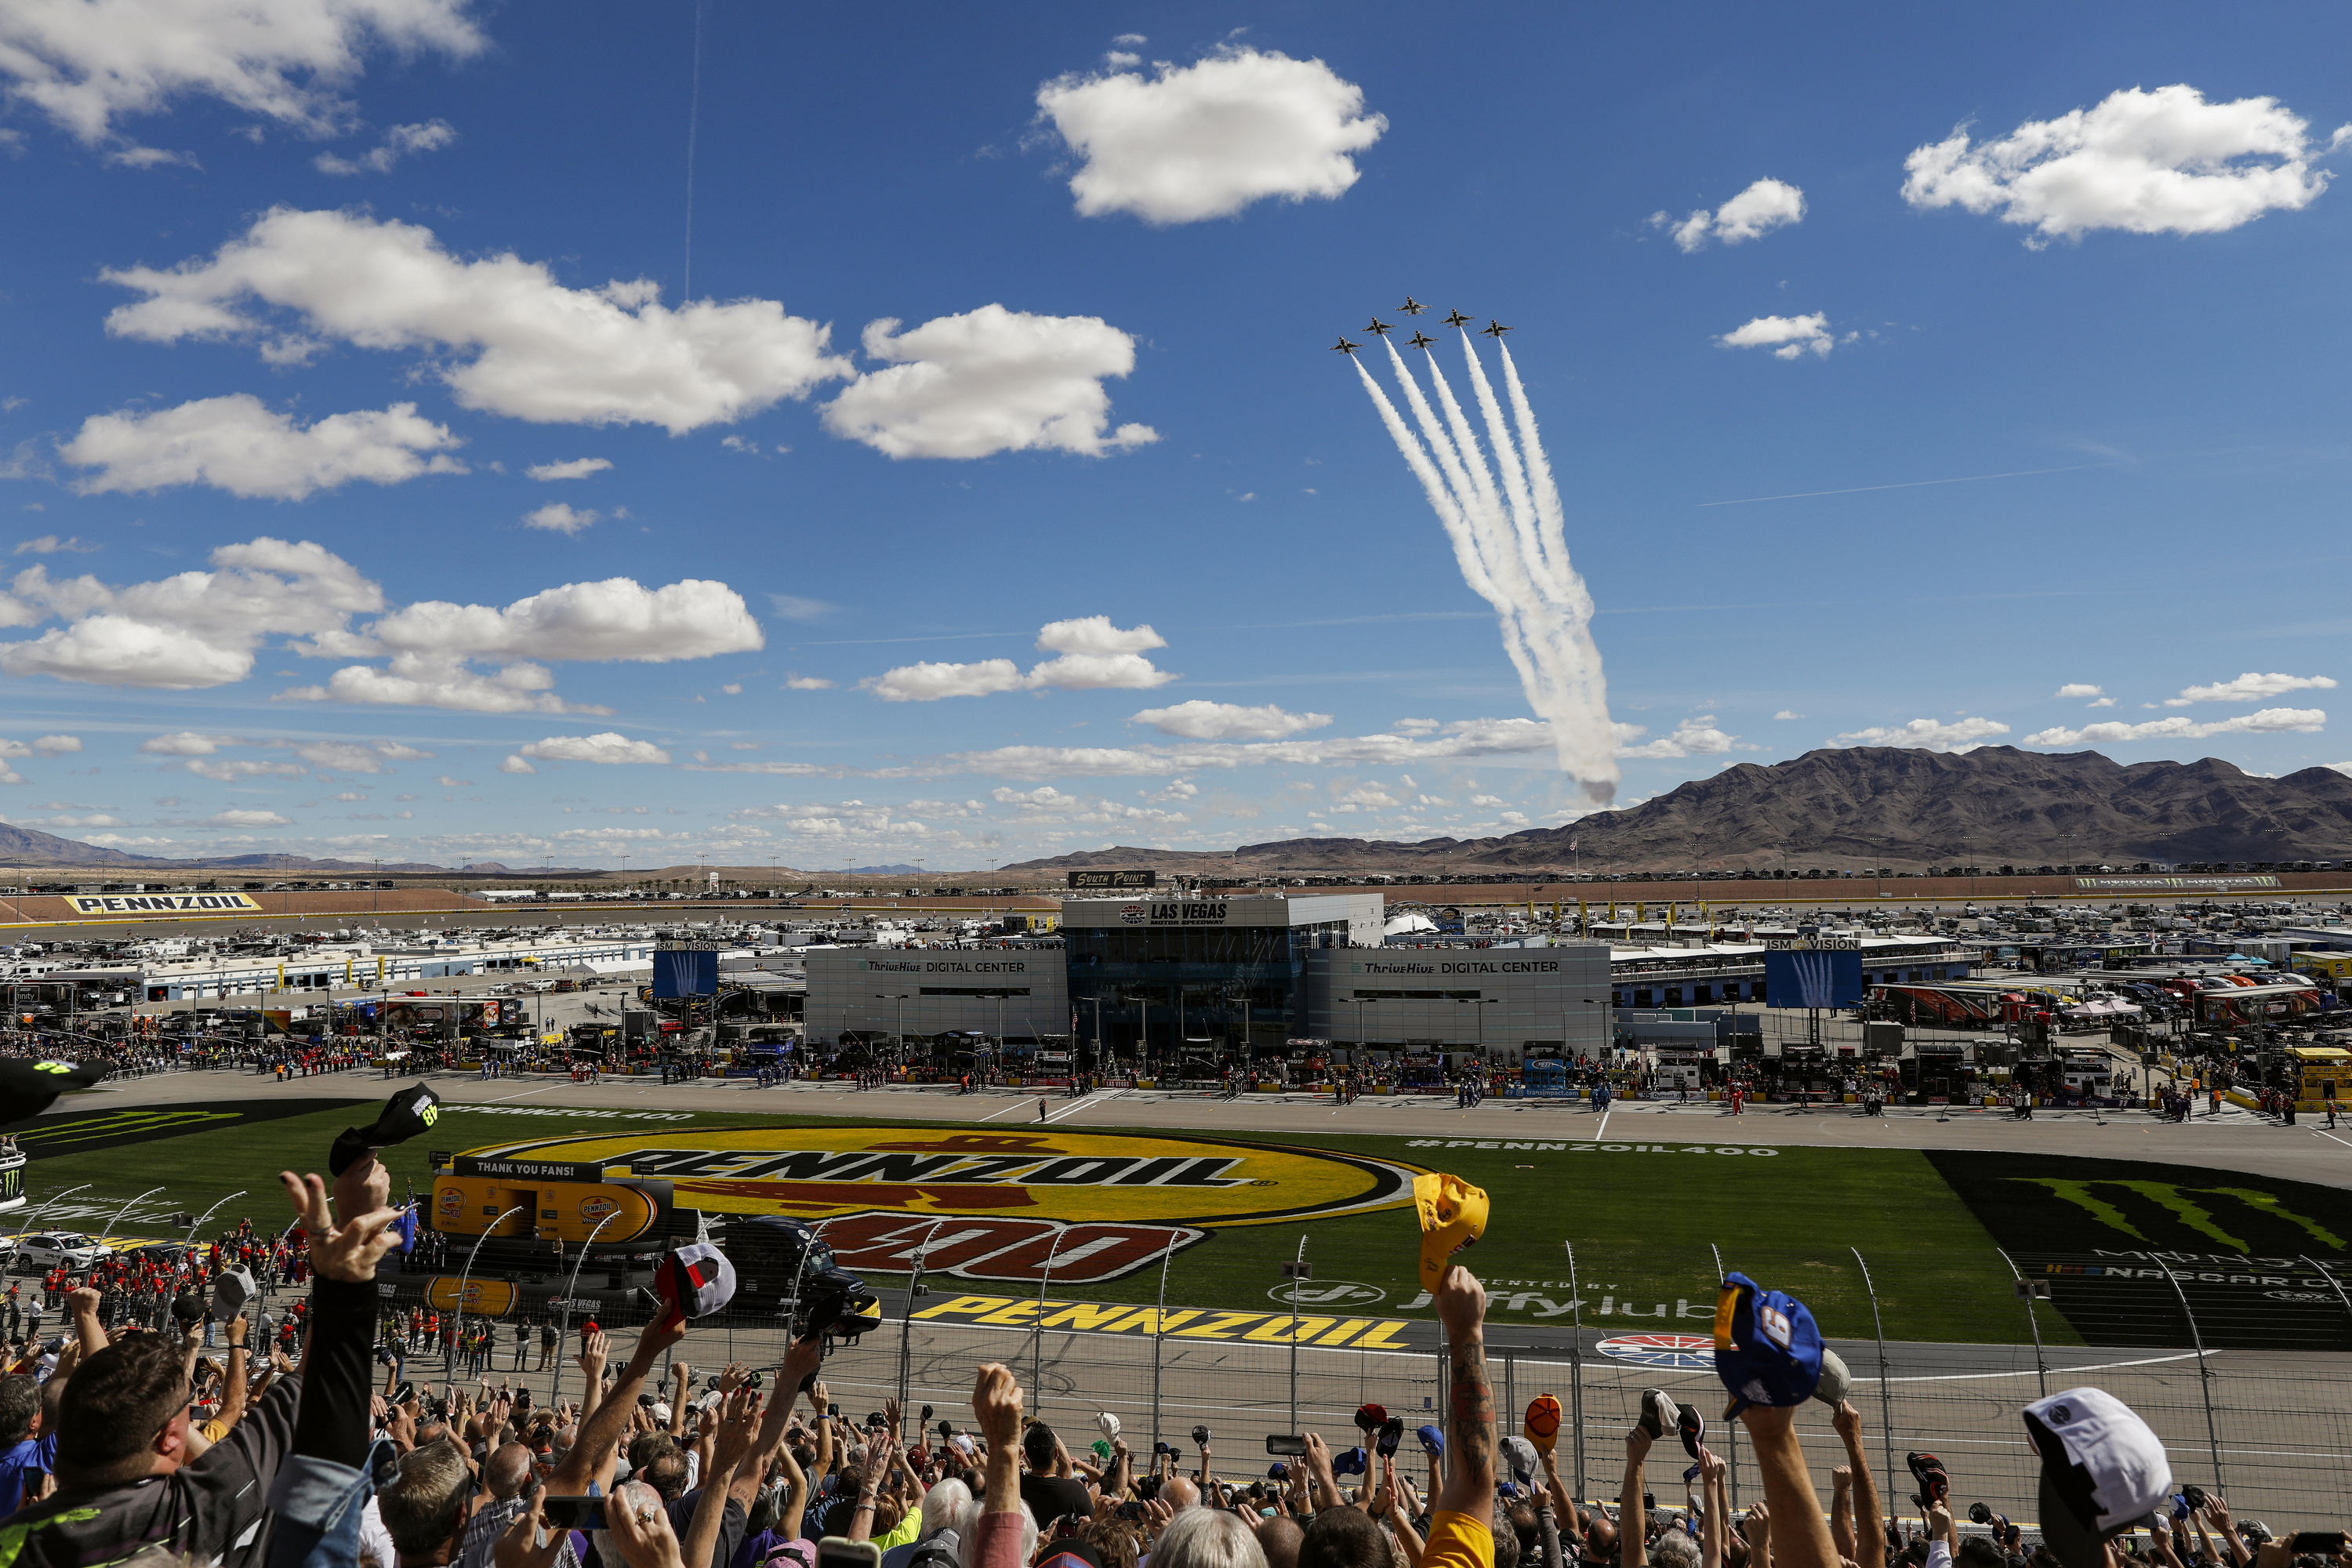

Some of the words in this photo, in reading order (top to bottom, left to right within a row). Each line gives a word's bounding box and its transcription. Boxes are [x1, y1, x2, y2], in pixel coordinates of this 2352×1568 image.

[1076, 873, 1109, 886] SOUTH
[1114, 872, 1147, 886] POINT
[74, 895, 257, 913] PENNZOIL
[1151, 904, 1178, 920] LAS
[1181, 903, 1227, 920] VEGAS
[686, 942, 717, 950] VISION
[1766, 941, 1791, 949] ISM
[1810, 940, 1858, 949] VISION
[927, 963, 971, 972] DIGITAL
[975, 962, 1025, 972] CENTER
[1441, 962, 1497, 973] DIGITAL
[1501, 961, 1559, 973] CENTER
[16, 992, 35, 1000] finity
[422, 1104, 438, 1127] 48
[477, 1162, 513, 1174] THANK
[517, 1164, 539, 1174] YOU
[543, 1165, 574, 1176] FANS!
[590, 1149, 1256, 1187] PENNZOIL
[450, 1208, 461, 1218] 400
[583, 1203, 612, 1213] PENNZOIL
[2105, 1267, 2288, 1287] NASCAR
[577, 1299, 601, 1309] VEGAS
[1396, 1288, 1588, 1317] jffy
[1599, 1296, 1717, 1319] lub
[909, 1296, 1410, 1348] PENNZOIL
